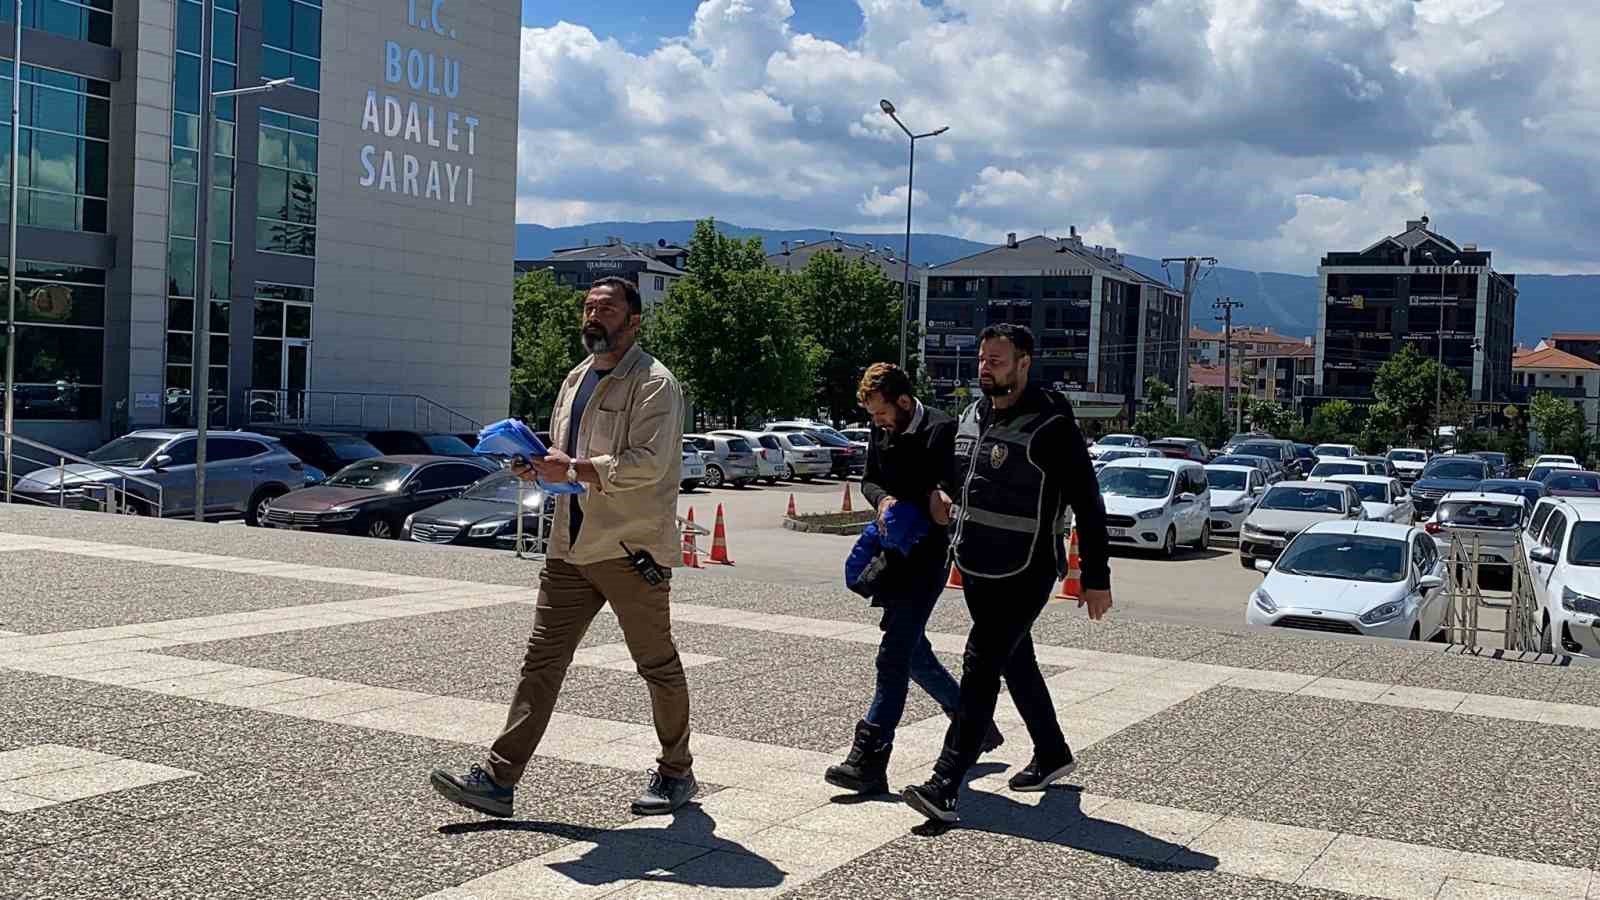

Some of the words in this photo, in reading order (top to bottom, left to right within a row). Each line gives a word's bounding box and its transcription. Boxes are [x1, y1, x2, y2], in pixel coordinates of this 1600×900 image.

[384, 40, 461, 98] BOLU
[361, 90, 480, 155] ADALET
[359, 144, 473, 206] SARAYI
